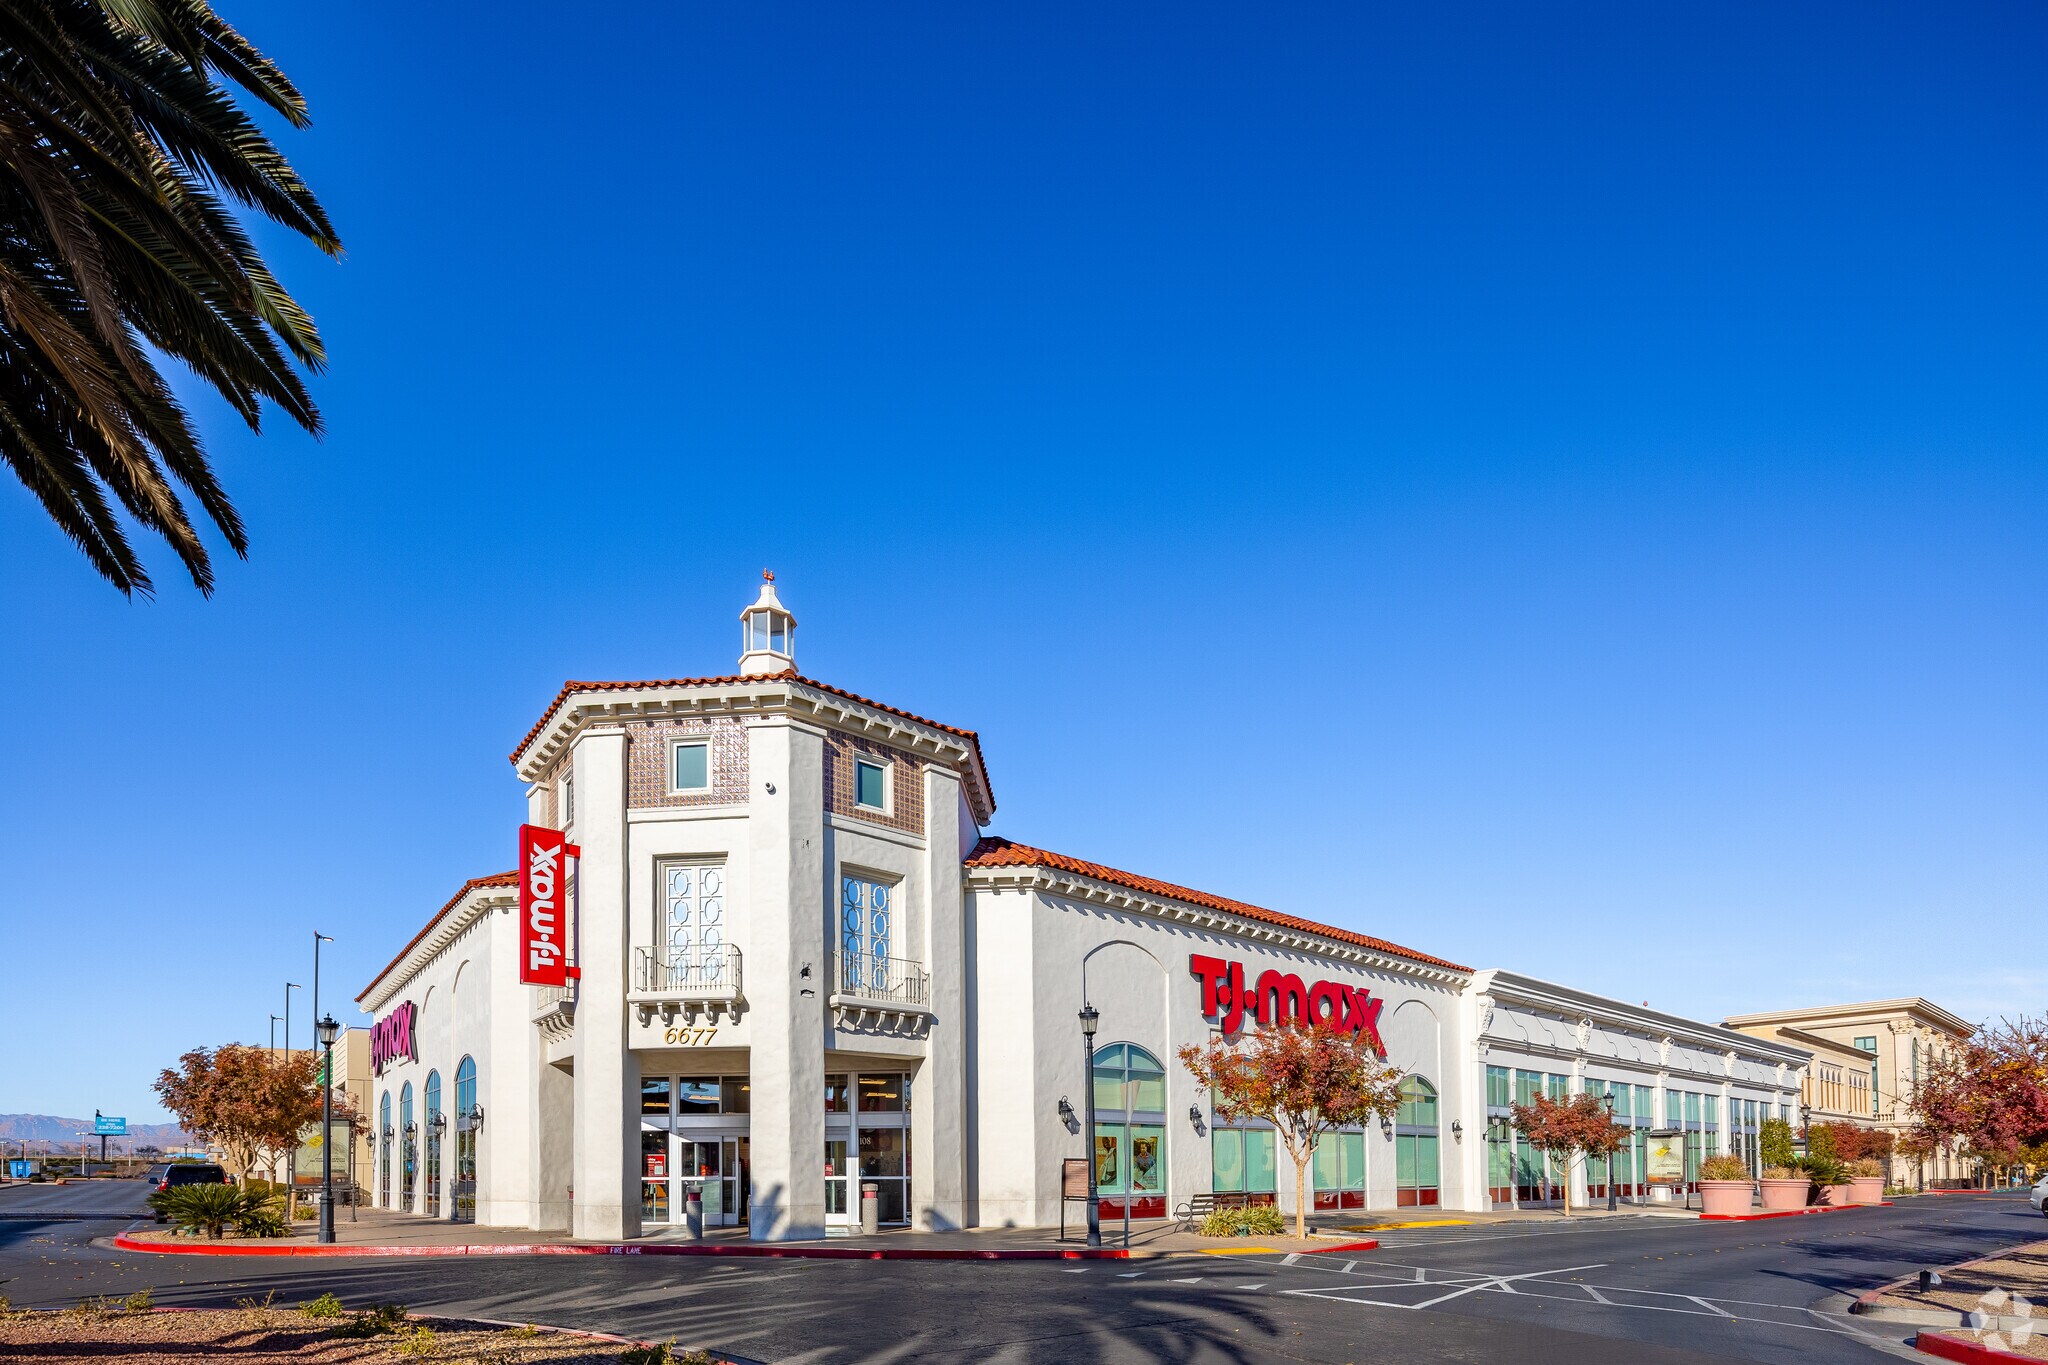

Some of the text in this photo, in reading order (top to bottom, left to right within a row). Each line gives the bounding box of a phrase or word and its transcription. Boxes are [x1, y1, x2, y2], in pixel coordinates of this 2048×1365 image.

[664, 1027, 718, 1046] 6677
[609, 1246, 642, 1255] FIRE LANE
